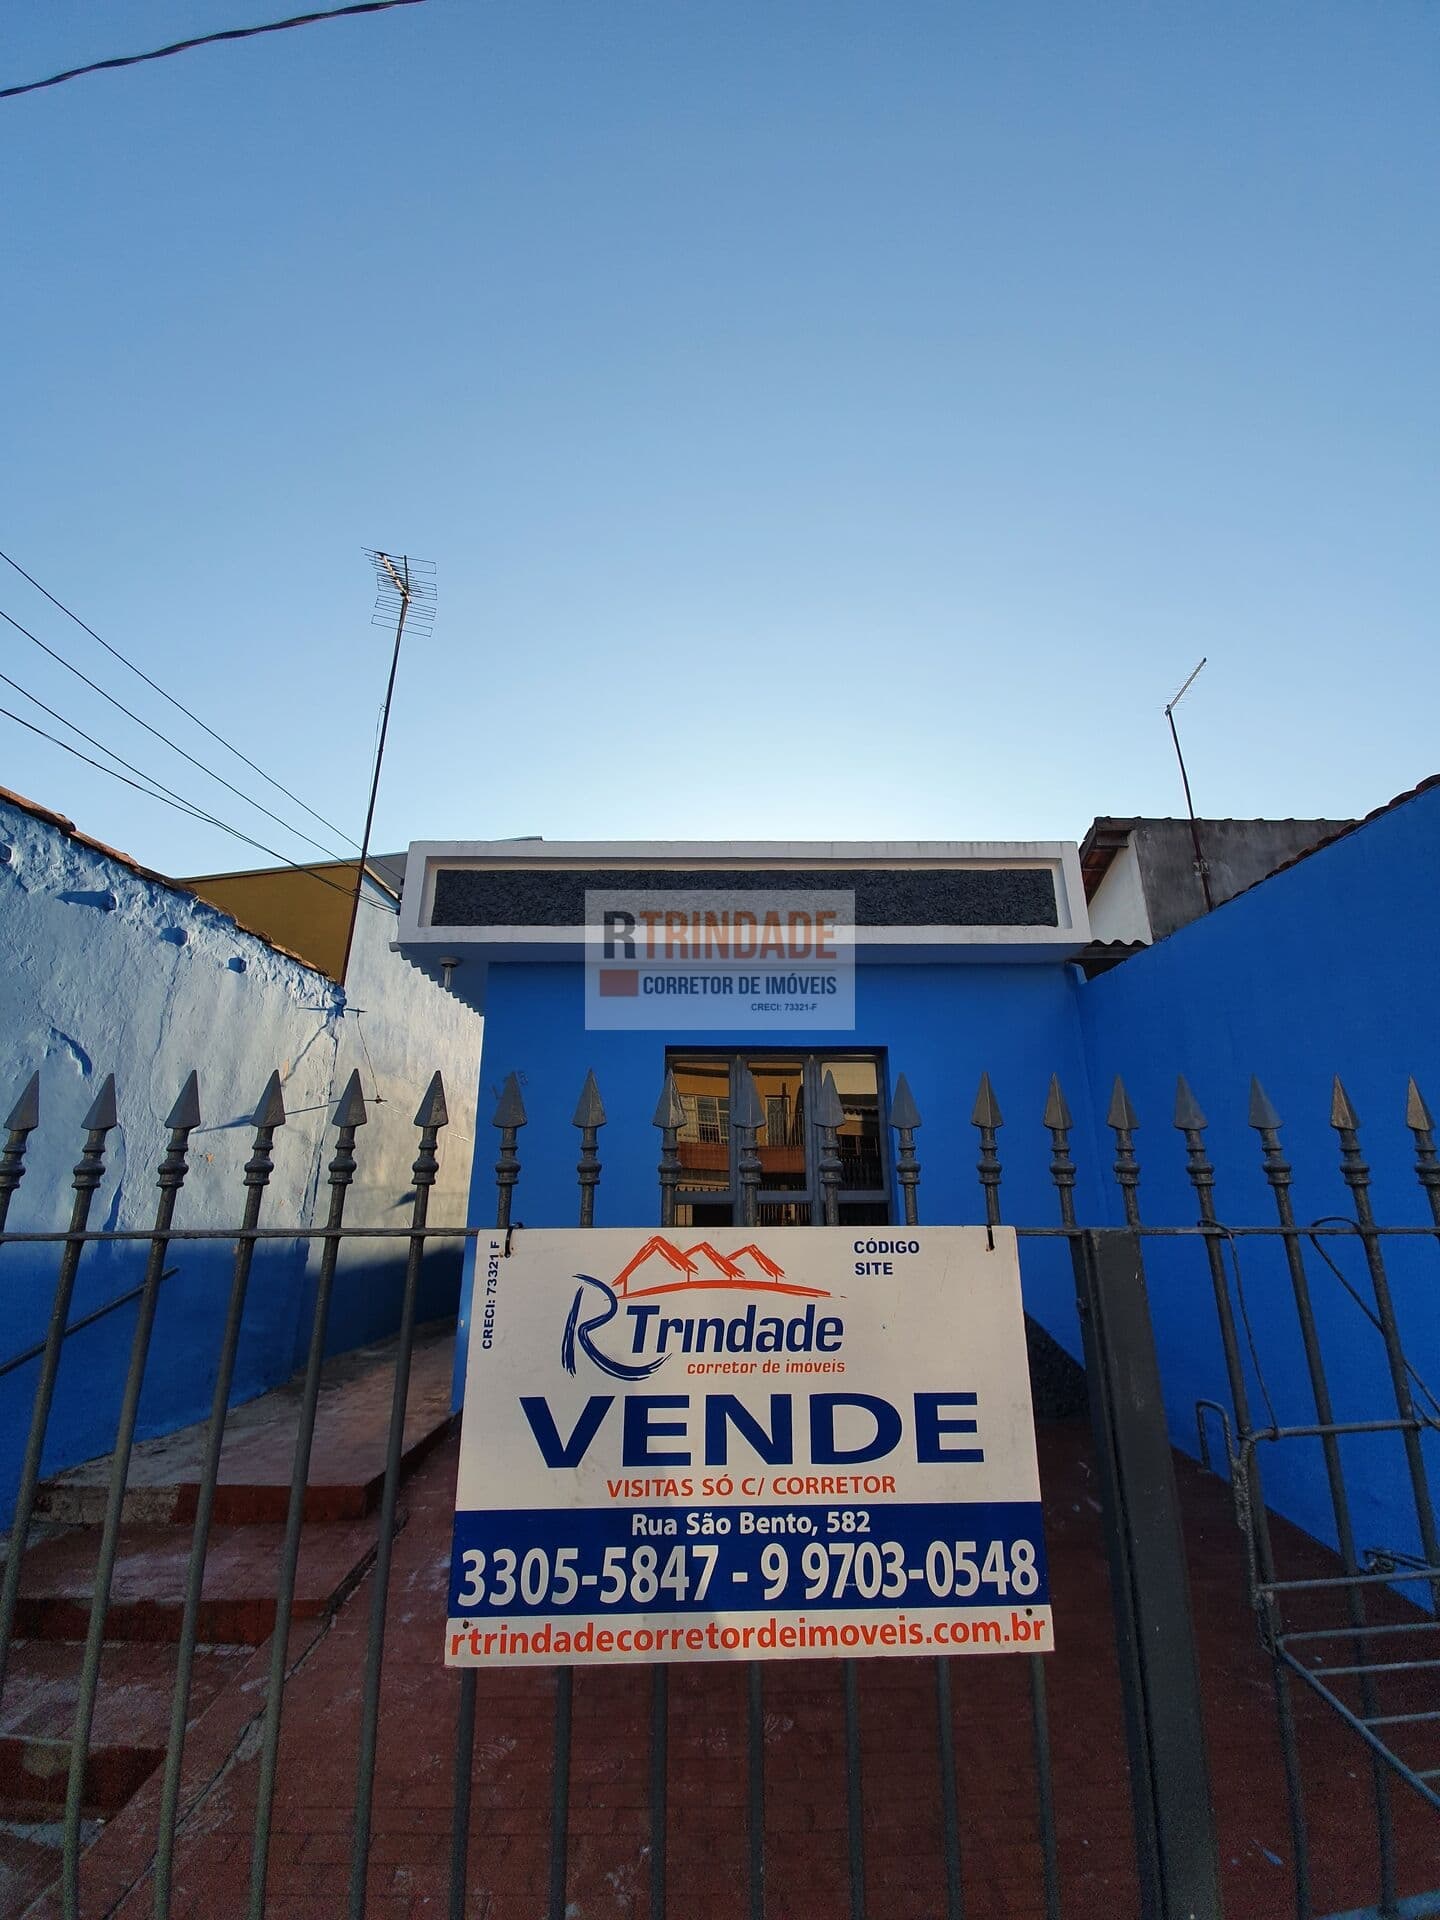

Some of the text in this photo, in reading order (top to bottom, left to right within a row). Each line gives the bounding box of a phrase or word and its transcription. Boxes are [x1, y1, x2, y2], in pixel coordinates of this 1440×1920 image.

[853, 1237, 920, 1254] CÓDIGO
[854, 1262, 894, 1276] SITE
[482, 1240, 500, 1350] CRECI: 73321 F
[626, 1303, 844, 1354] Trindade
[687, 1358, 846, 1375] corretor de imóveis
[519, 1391, 984, 1468] VENDE
[606, 1474, 896, 1498] VISITAS SÓ C/ CORRETOR
[631, 1511, 871, 1537] Rua São Bento, 582
[457, 1545, 719, 1607] 3305-5847
[760, 1543, 789, 1600] 9
[801, 1539, 1039, 1600] 9703-0548
[450, 1612, 1046, 1656] rtrindadecorretordeimoveis.com.br
